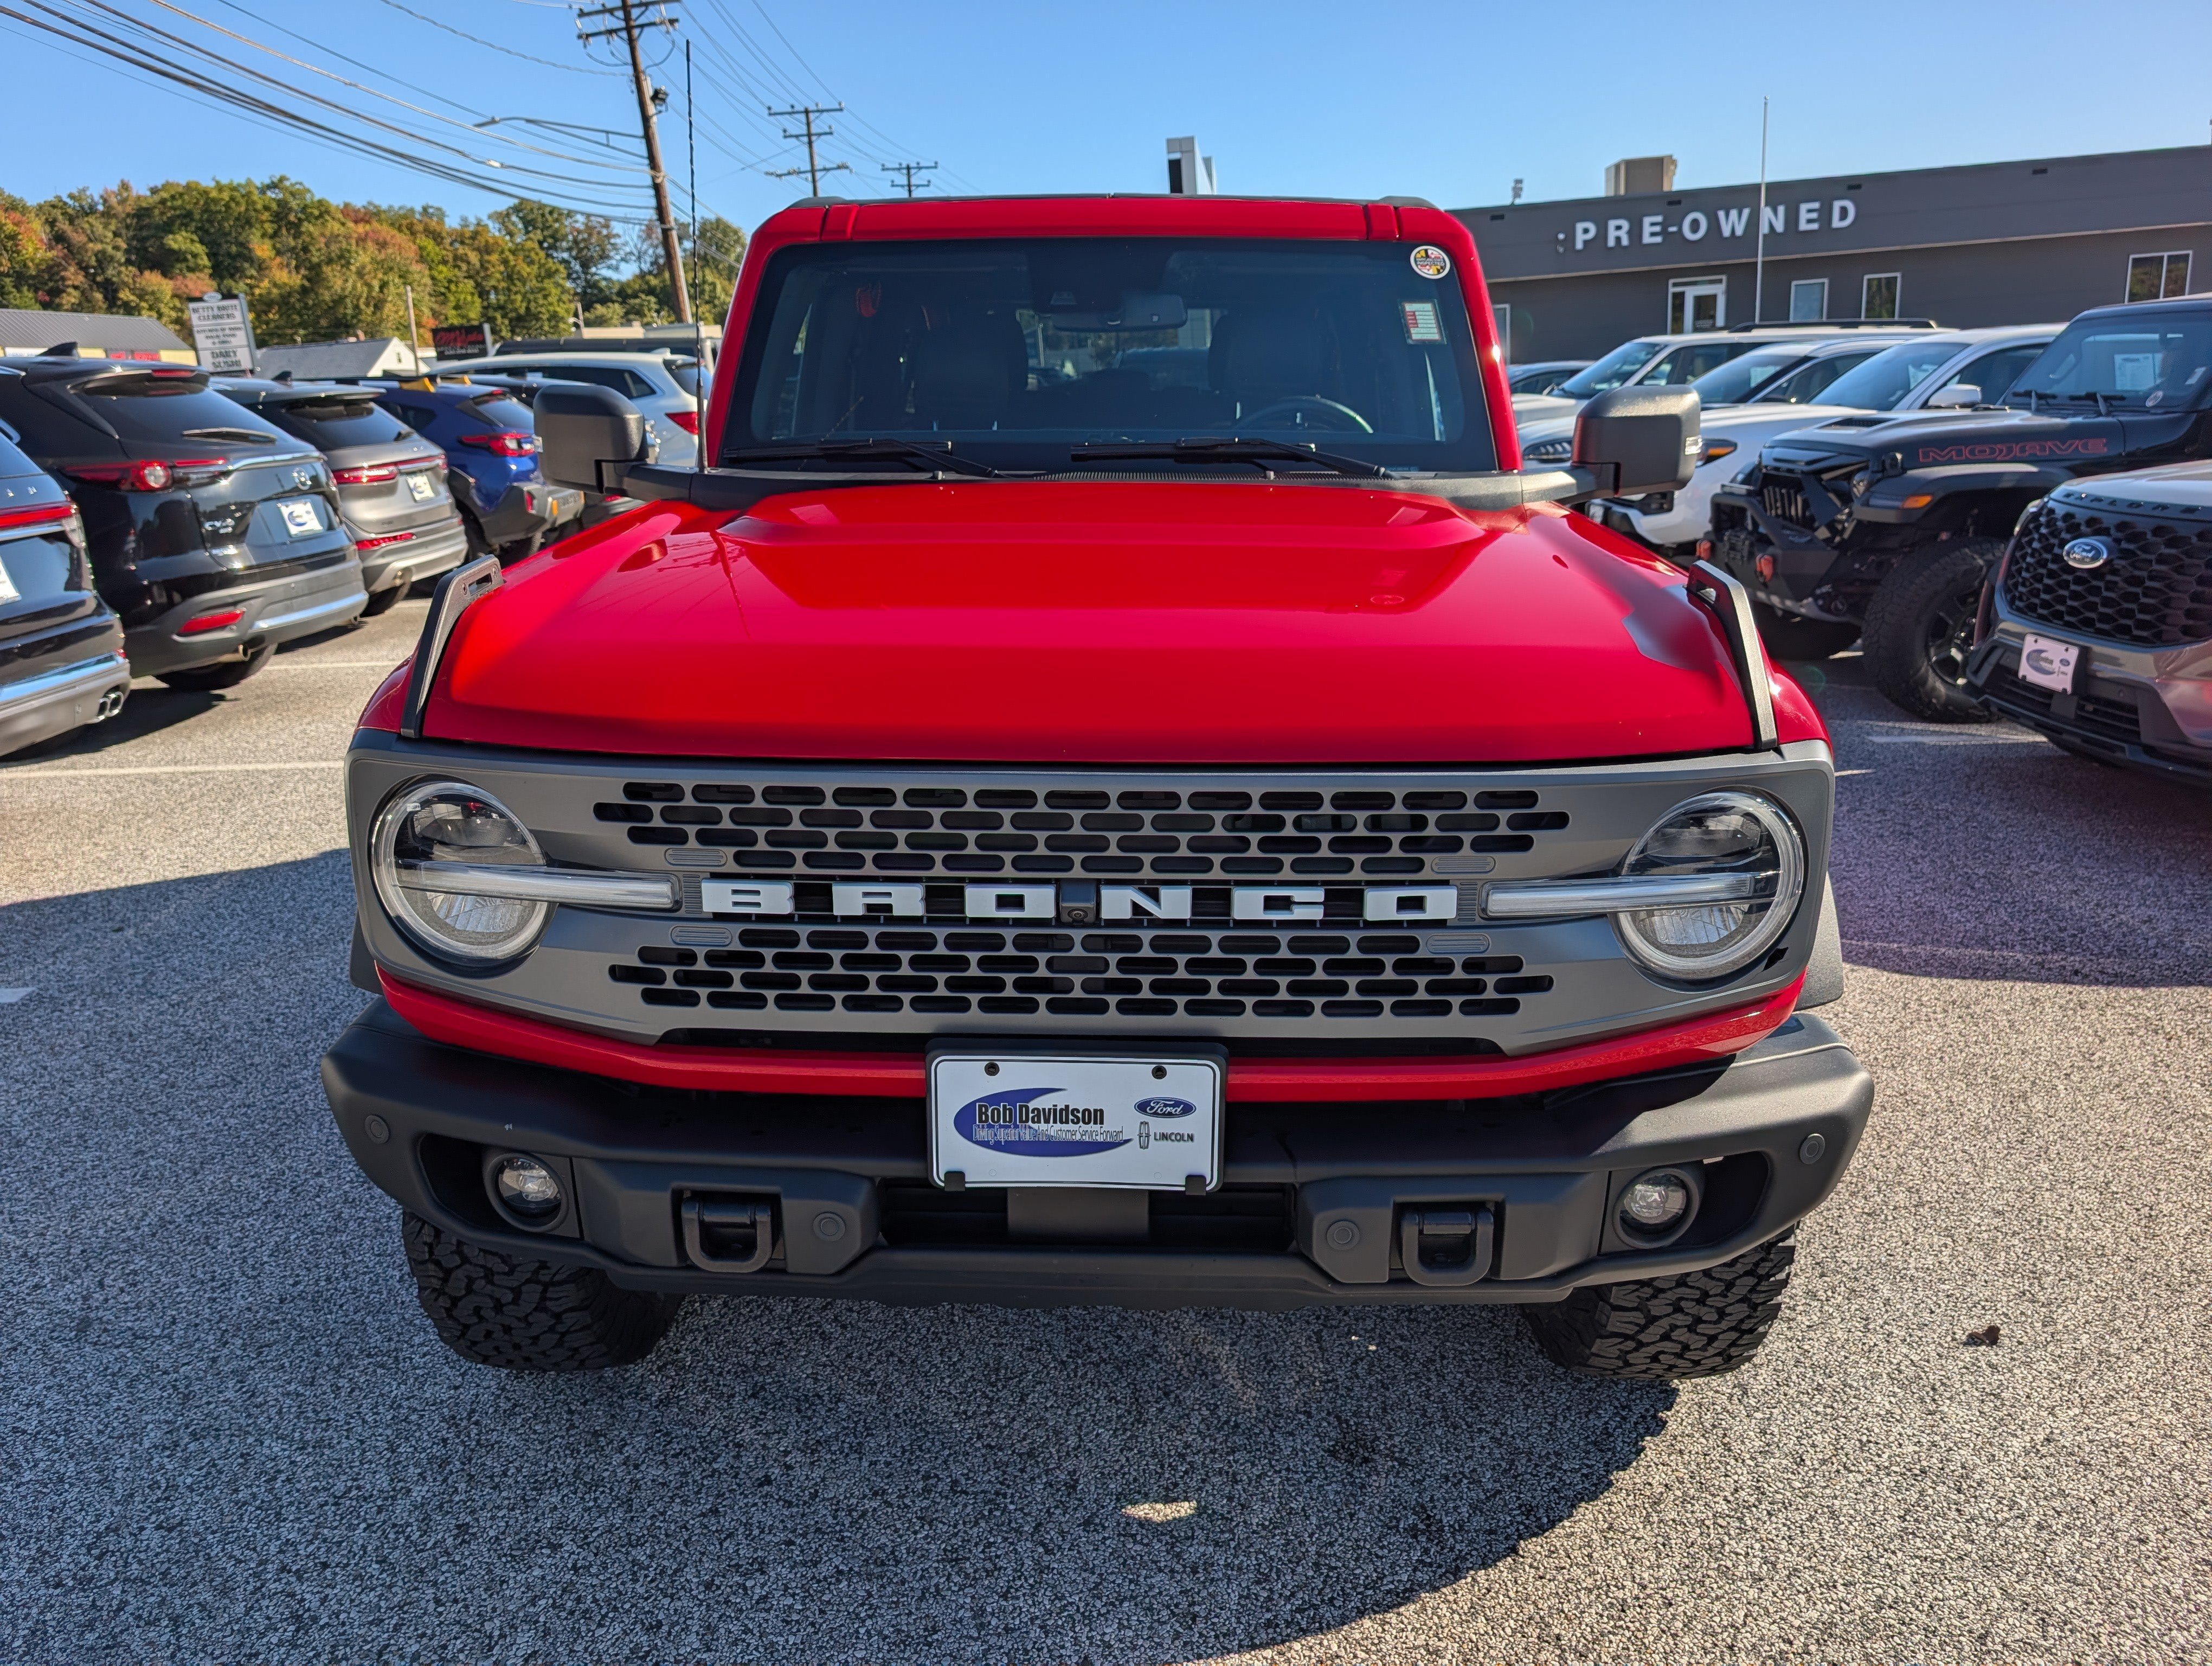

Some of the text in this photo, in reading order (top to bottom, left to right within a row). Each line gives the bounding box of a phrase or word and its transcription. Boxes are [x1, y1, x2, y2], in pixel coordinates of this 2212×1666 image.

[1575, 199, 1856, 251] PRE-OWNED
[1918, 438, 2107, 462] MOJAVE
[700, 877, 1458, 922] BRONCO
[977, 1103, 1104, 1125] Bob Davidson
[1147, 1100, 1184, 1114] Ford
[973, 1124, 1123, 1145] Driving Superior Value And Customer Service Forward
[1154, 1131, 1194, 1142] LINCOLN
